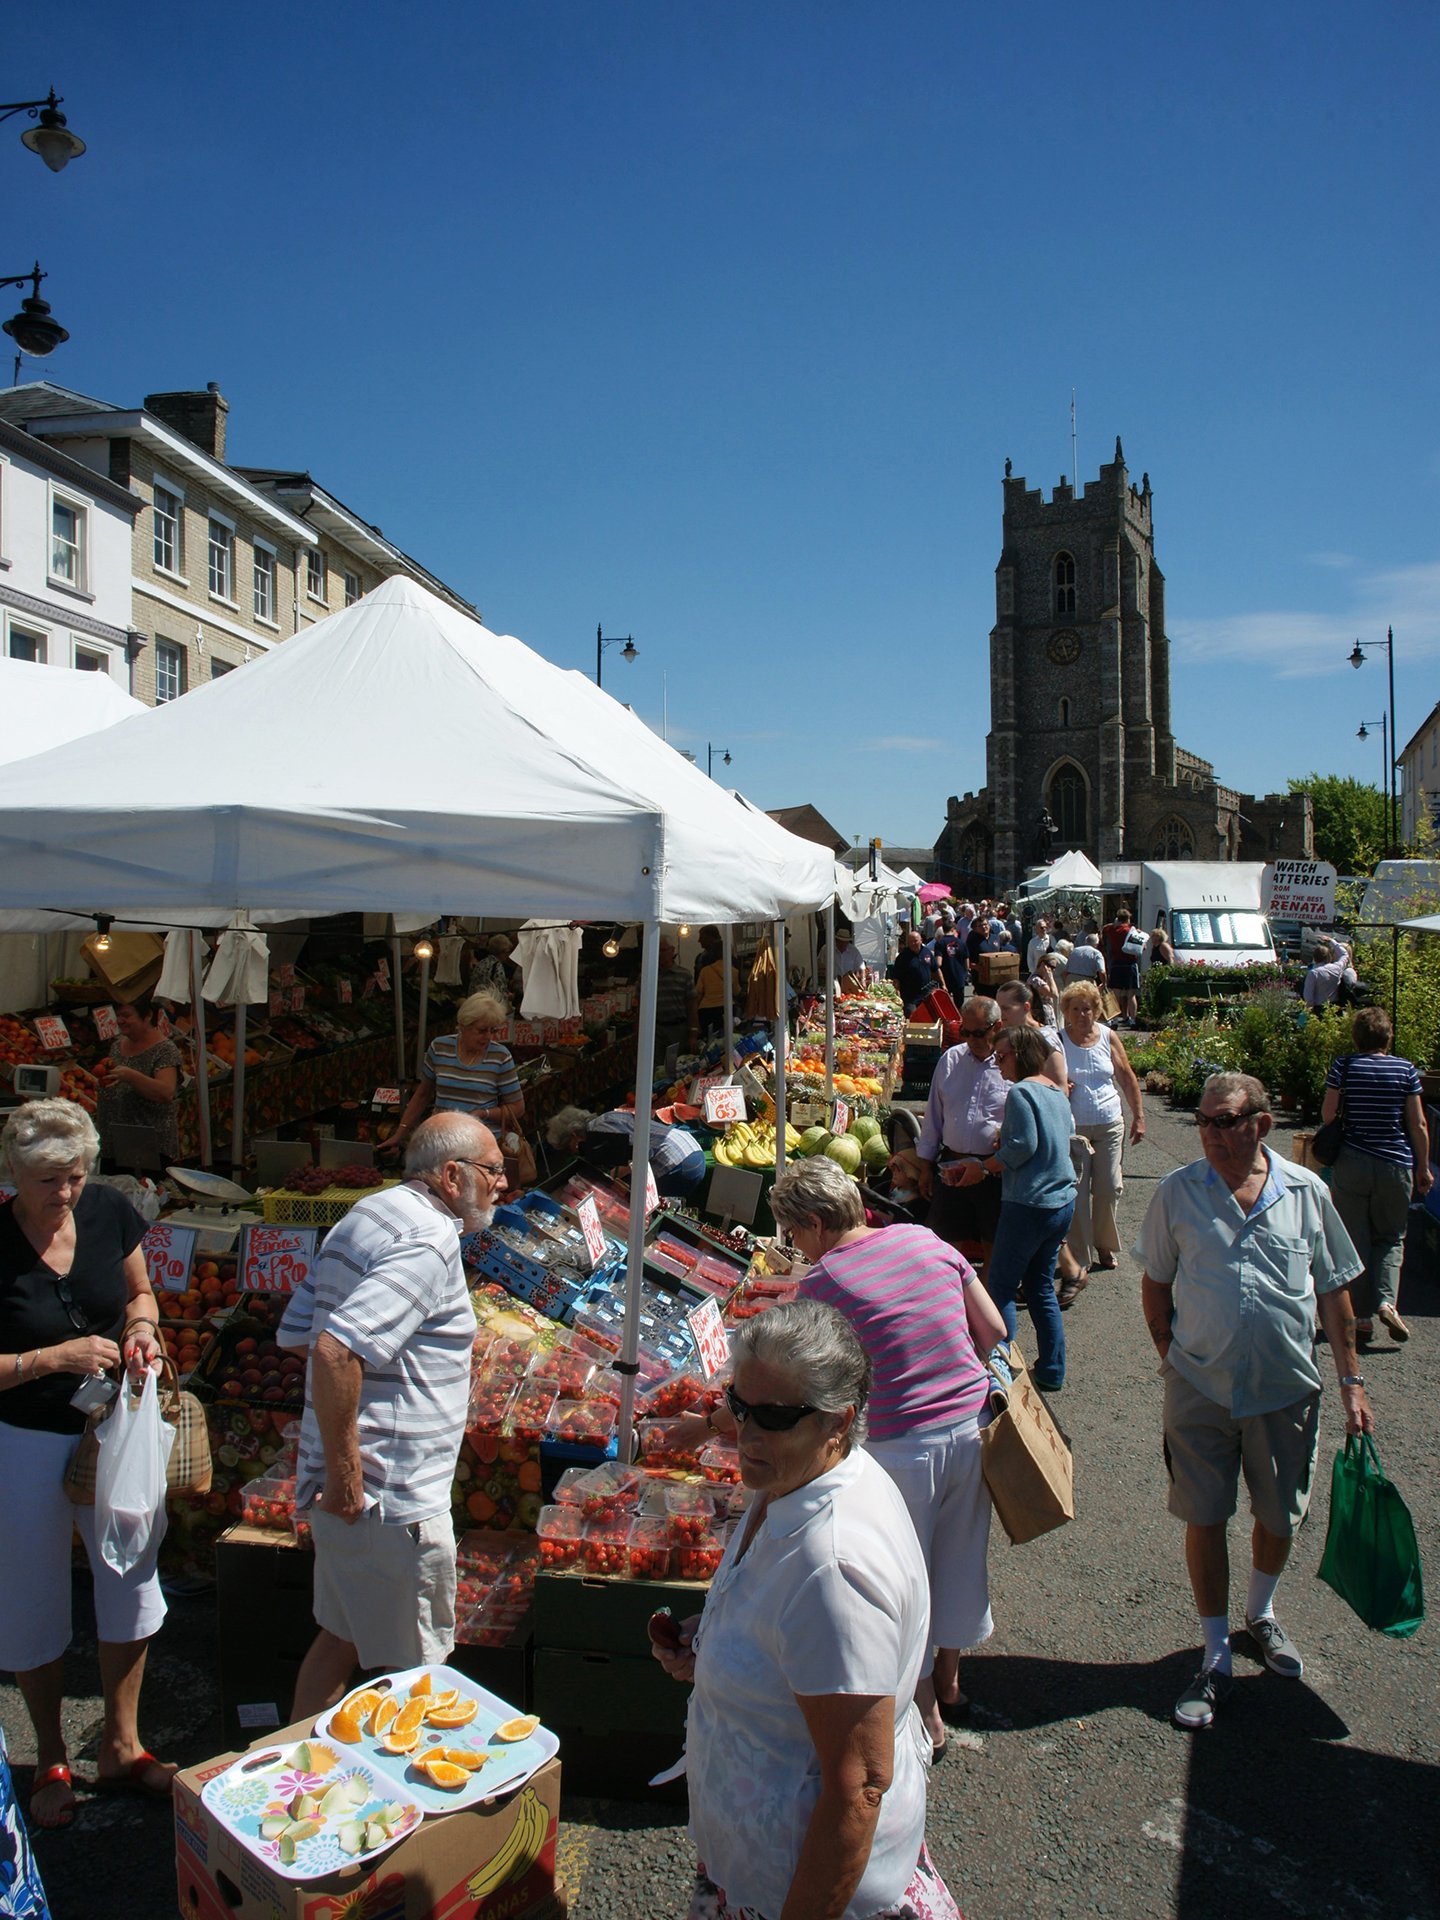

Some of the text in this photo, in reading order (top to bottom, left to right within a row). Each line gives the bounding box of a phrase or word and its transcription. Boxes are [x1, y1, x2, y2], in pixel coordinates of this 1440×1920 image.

[1276, 861, 1318, 873] WATCH
[1273, 873, 1330, 886] ATTERIES
[1270, 900, 1326, 913] RENATA
[1282, 912, 1328, 920] SWITZERLAND
